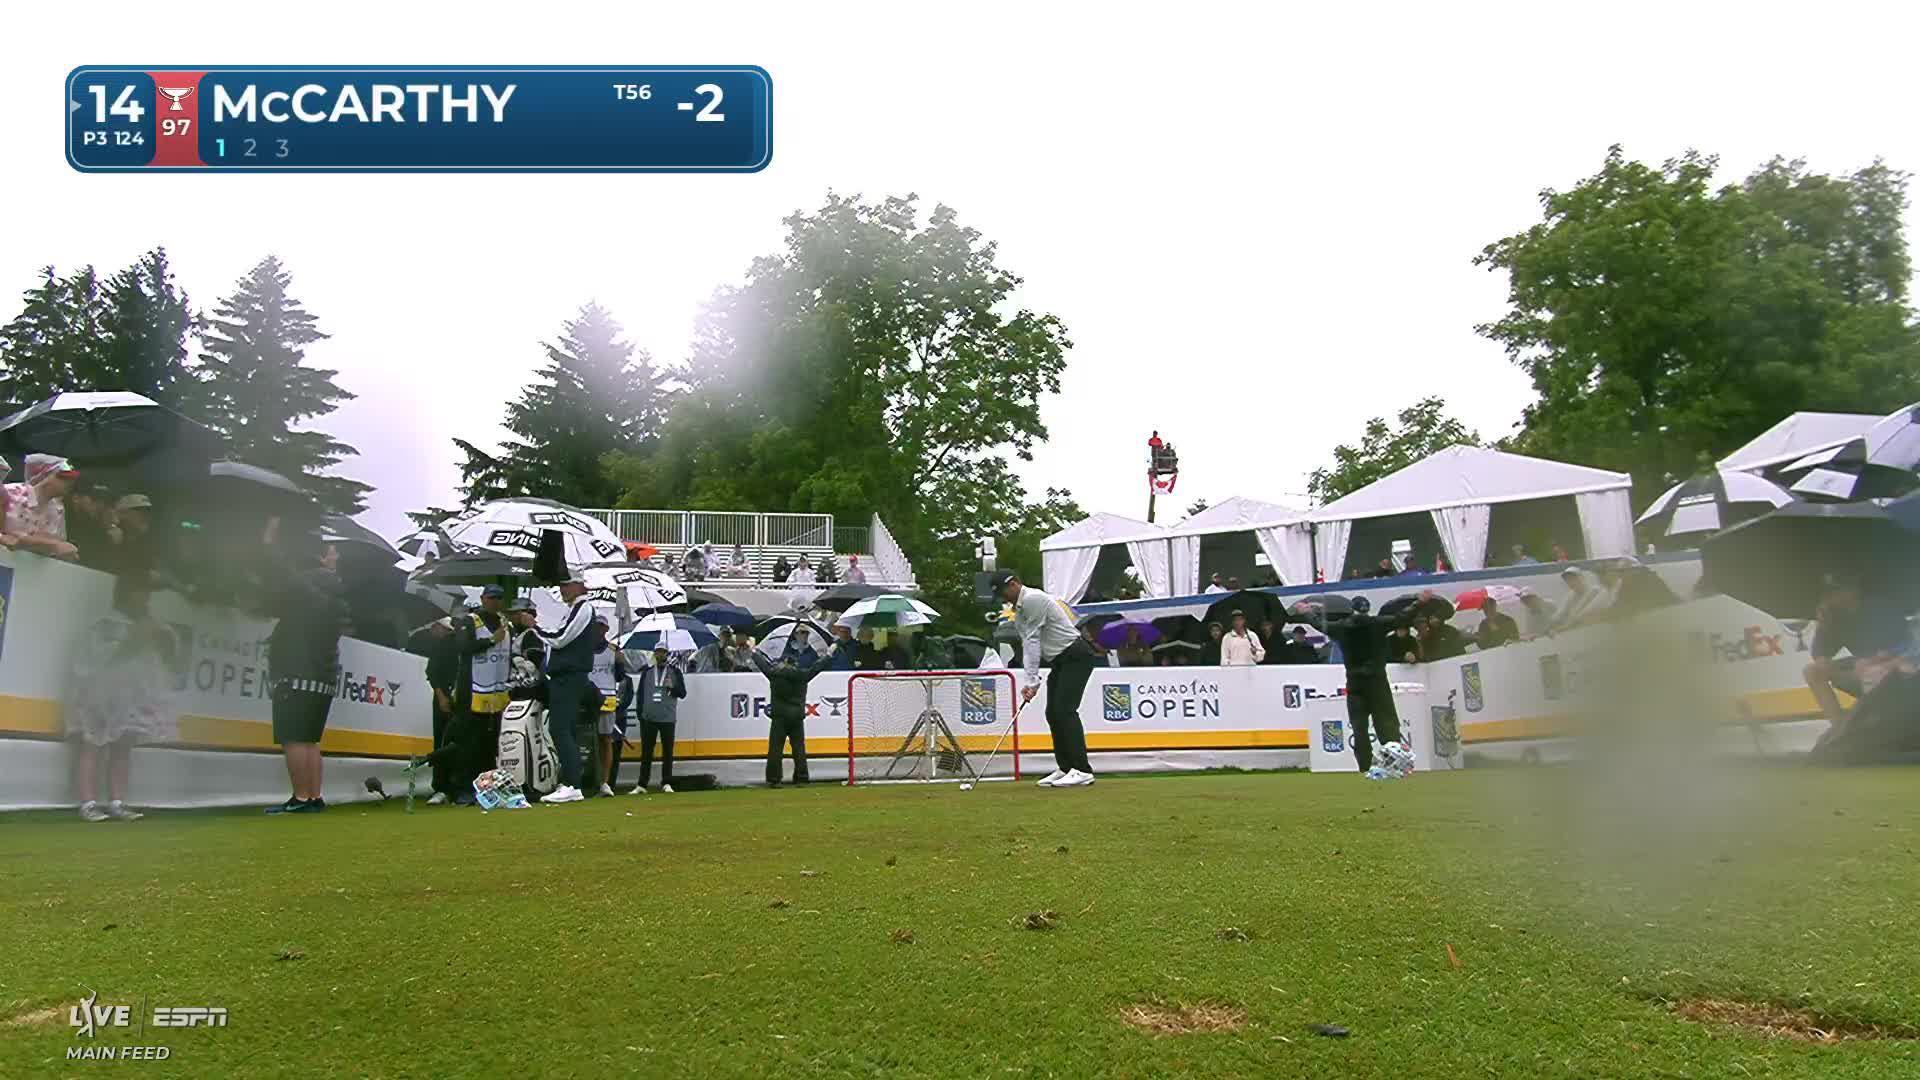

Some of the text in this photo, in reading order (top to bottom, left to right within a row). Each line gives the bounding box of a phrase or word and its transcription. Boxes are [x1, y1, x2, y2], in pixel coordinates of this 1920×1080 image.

[343, 672, 384, 705] FedEx
[1137, 680, 1219, 695] CANADIAN
[753, 696, 821, 719] Fex
[964, 710, 994, 723] RBC
[1106, 699, 1220, 720] RBC OPEN
